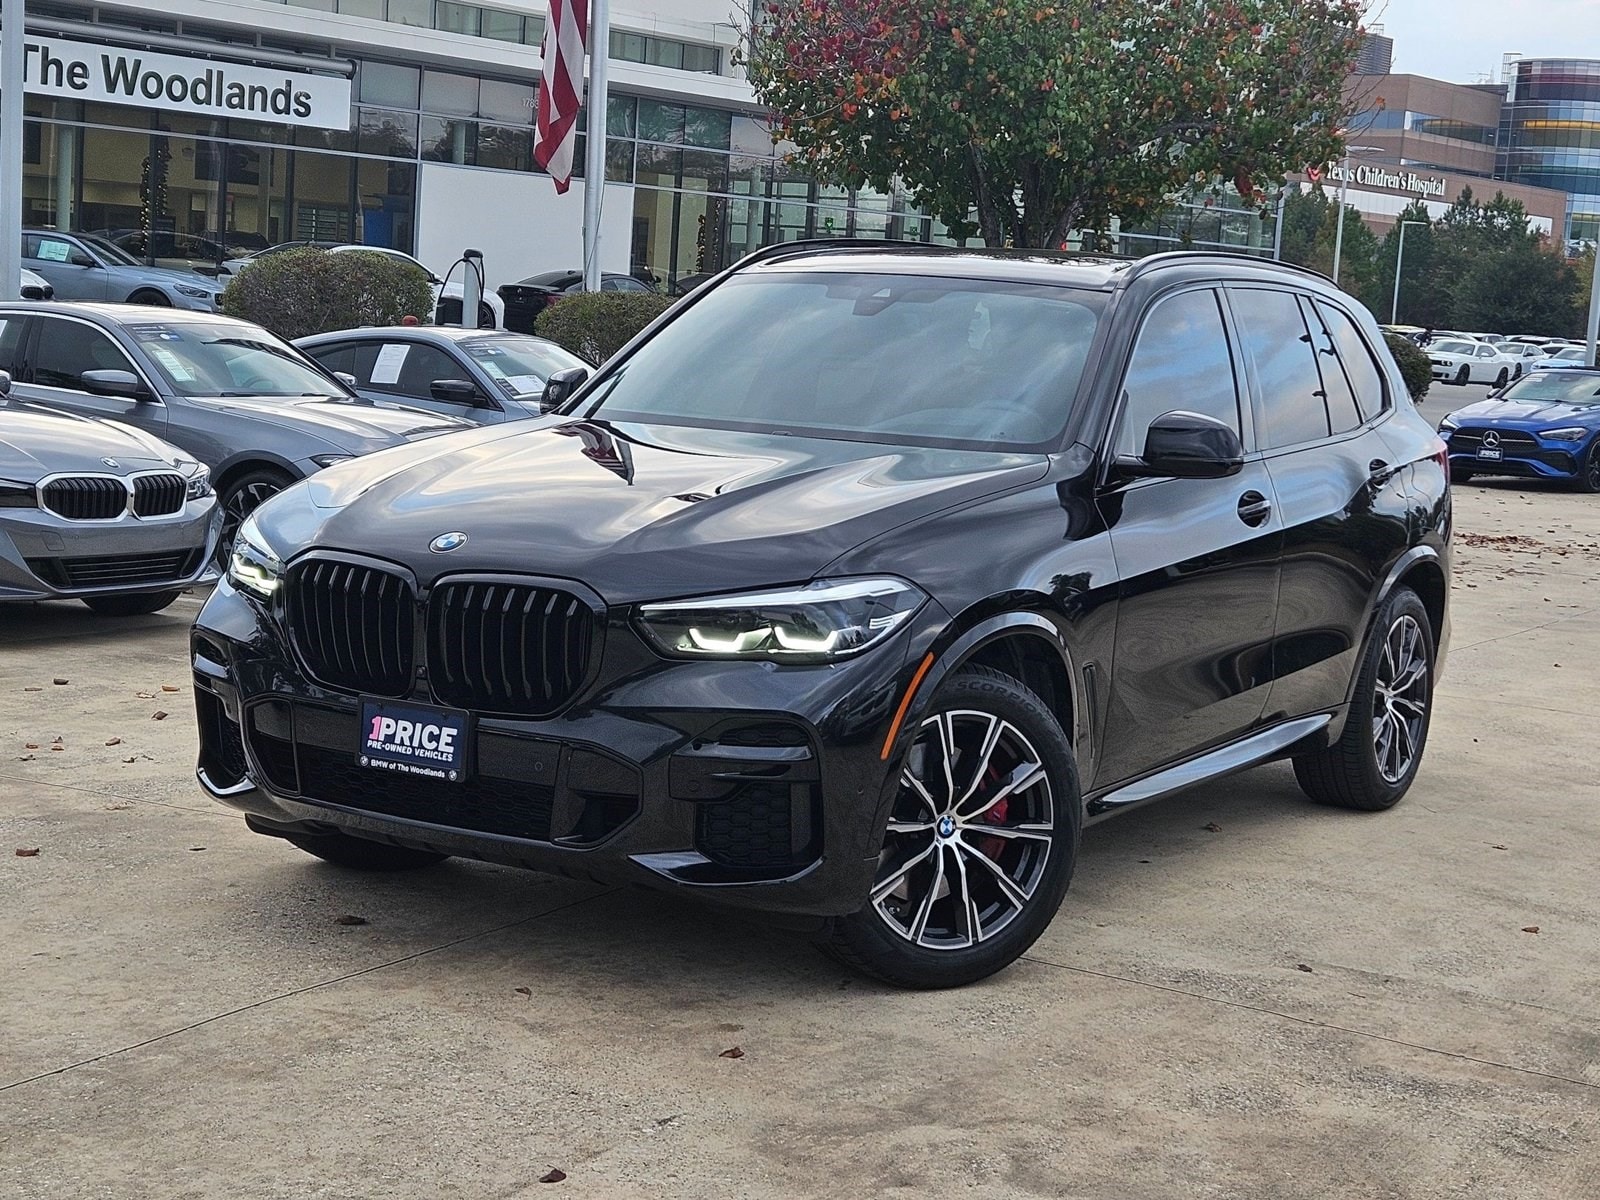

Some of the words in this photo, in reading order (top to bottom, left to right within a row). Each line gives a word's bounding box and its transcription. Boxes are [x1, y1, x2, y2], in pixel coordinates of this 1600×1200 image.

[23, 44, 90, 90] The
[101, 54, 312, 118] Woodlands
[1356, 165, 1407, 188] Children's
[1407, 173, 1445, 198] Hospital
[367, 740, 412, 755] PRE-OWNED
[414, 748, 453, 762] VEHICLES
[370, 759, 388, 768] BMW
[388, 762, 396, 770] of
[397, 763, 409, 772] The
[410, 765, 445, 778] Woodlands
